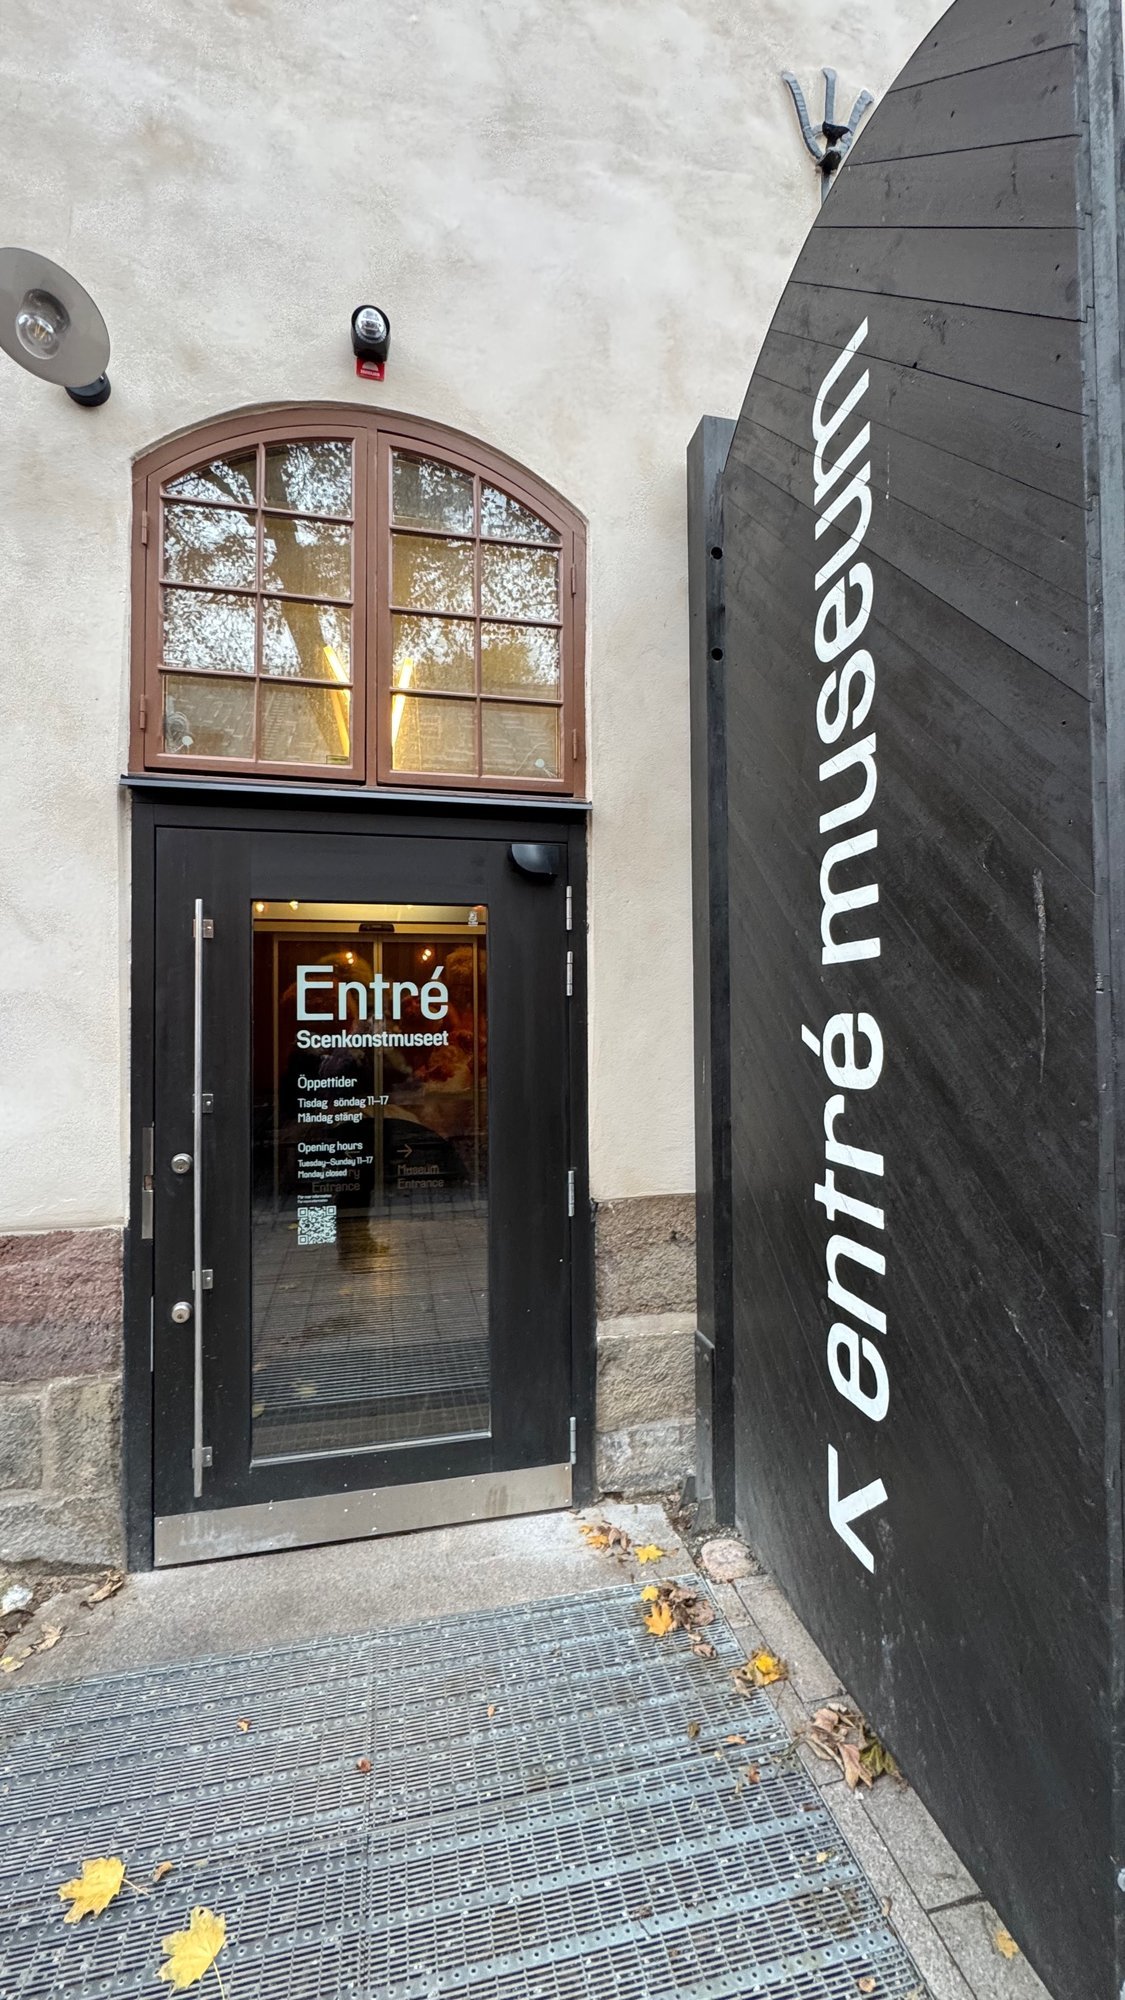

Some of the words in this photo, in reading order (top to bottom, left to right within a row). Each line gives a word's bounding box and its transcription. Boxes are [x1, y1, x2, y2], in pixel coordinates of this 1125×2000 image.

[811, 316, 881, 966] museum
[296, 965, 450, 1021] Entré
[296, 1029, 450, 1049] Scenkonstmuseet
[297, 1074, 358, 1092] Öppettider
[297, 1098, 329, 1110] Tisdag
[333, 1096, 367, 1109] söndag
[297, 1112, 334, 1124] Måndag
[334, 1111, 363, 1123] stängt
[297, 1142, 336, 1155] Opening
[336, 1140, 364, 1151] hours
[297, 1169, 325, 1180] Monday
[325, 1168, 348, 1178] closed
[397, 1164, 440, 1177] Museum
[311, 1180, 361, 1194] Entrance
[397, 1178, 445, 1190] Entrance
[802, 1011, 890, 1422] entré
